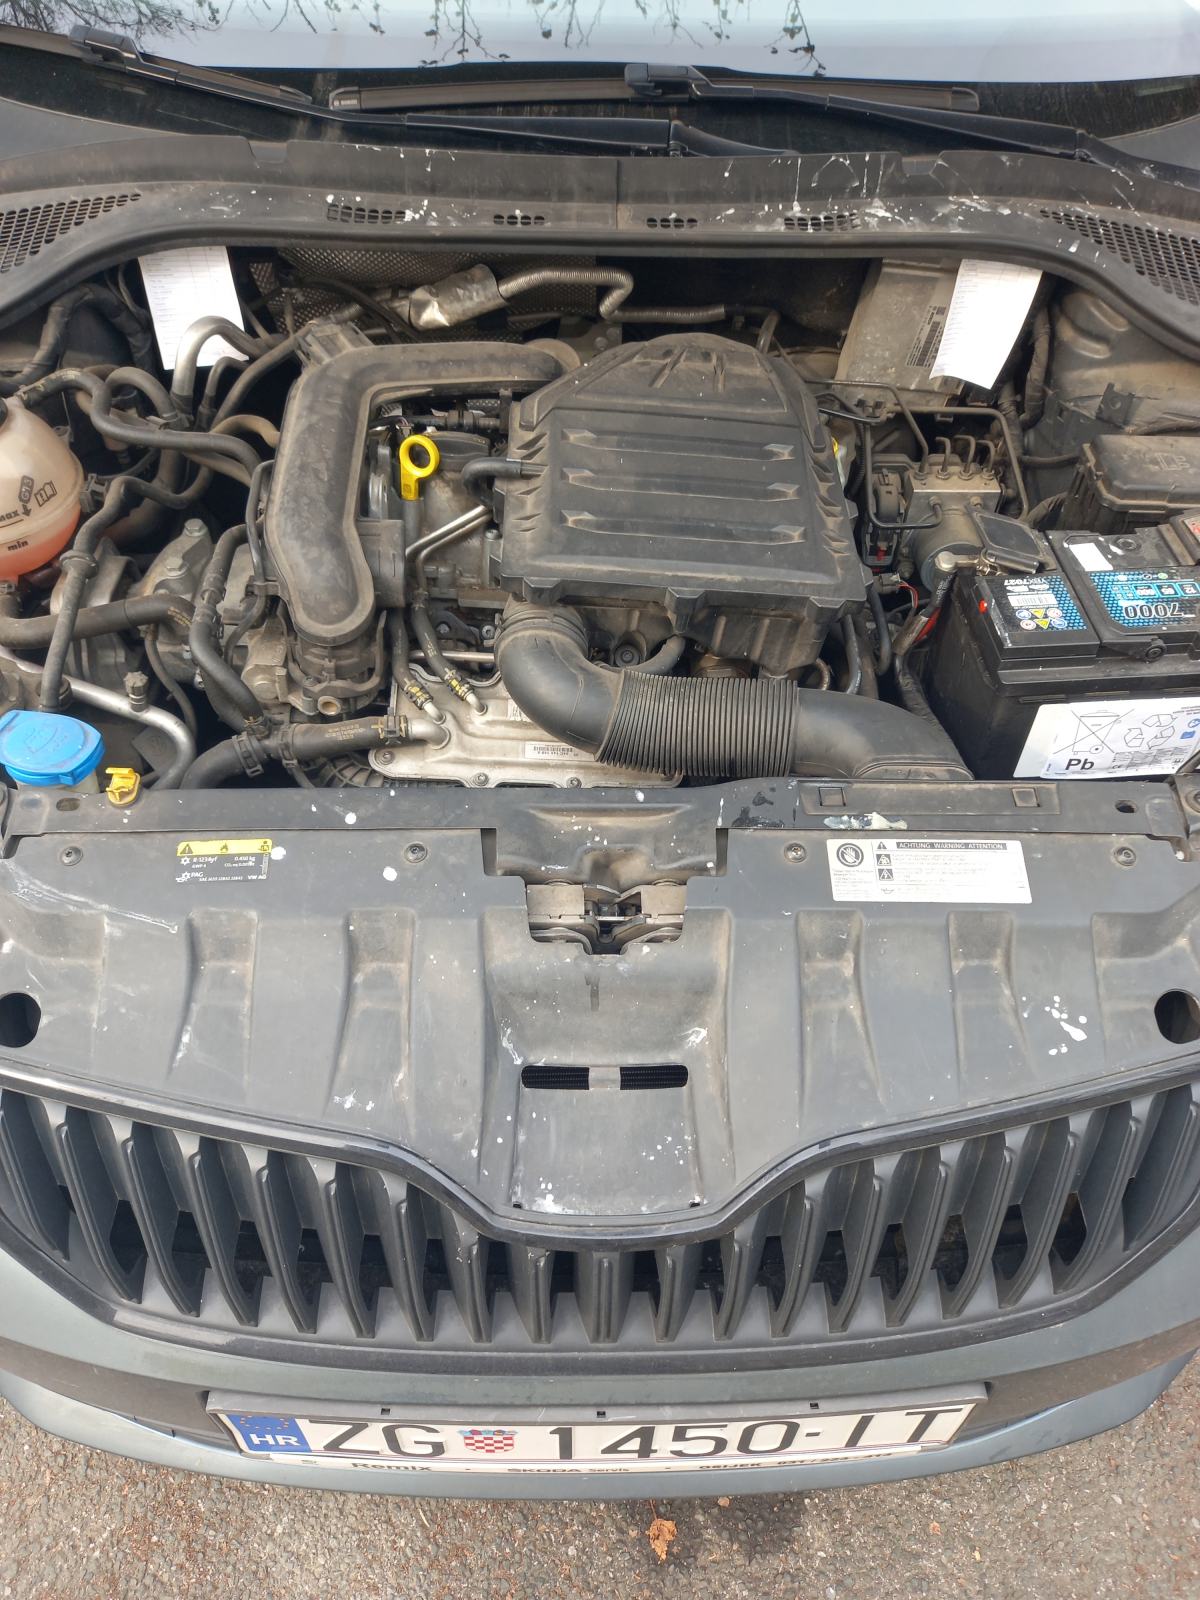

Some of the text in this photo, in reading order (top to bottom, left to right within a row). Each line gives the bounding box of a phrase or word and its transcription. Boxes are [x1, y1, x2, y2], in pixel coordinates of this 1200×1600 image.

[8, 541, 29, 551] min
[1123, 602, 1184, 619] 7000
[1065, 758, 1095, 771] Pb
[250, 1433, 301, 1446] HR
[308, 1418, 446, 1458] ZG
[351, 1462, 433, 1471] Remix
